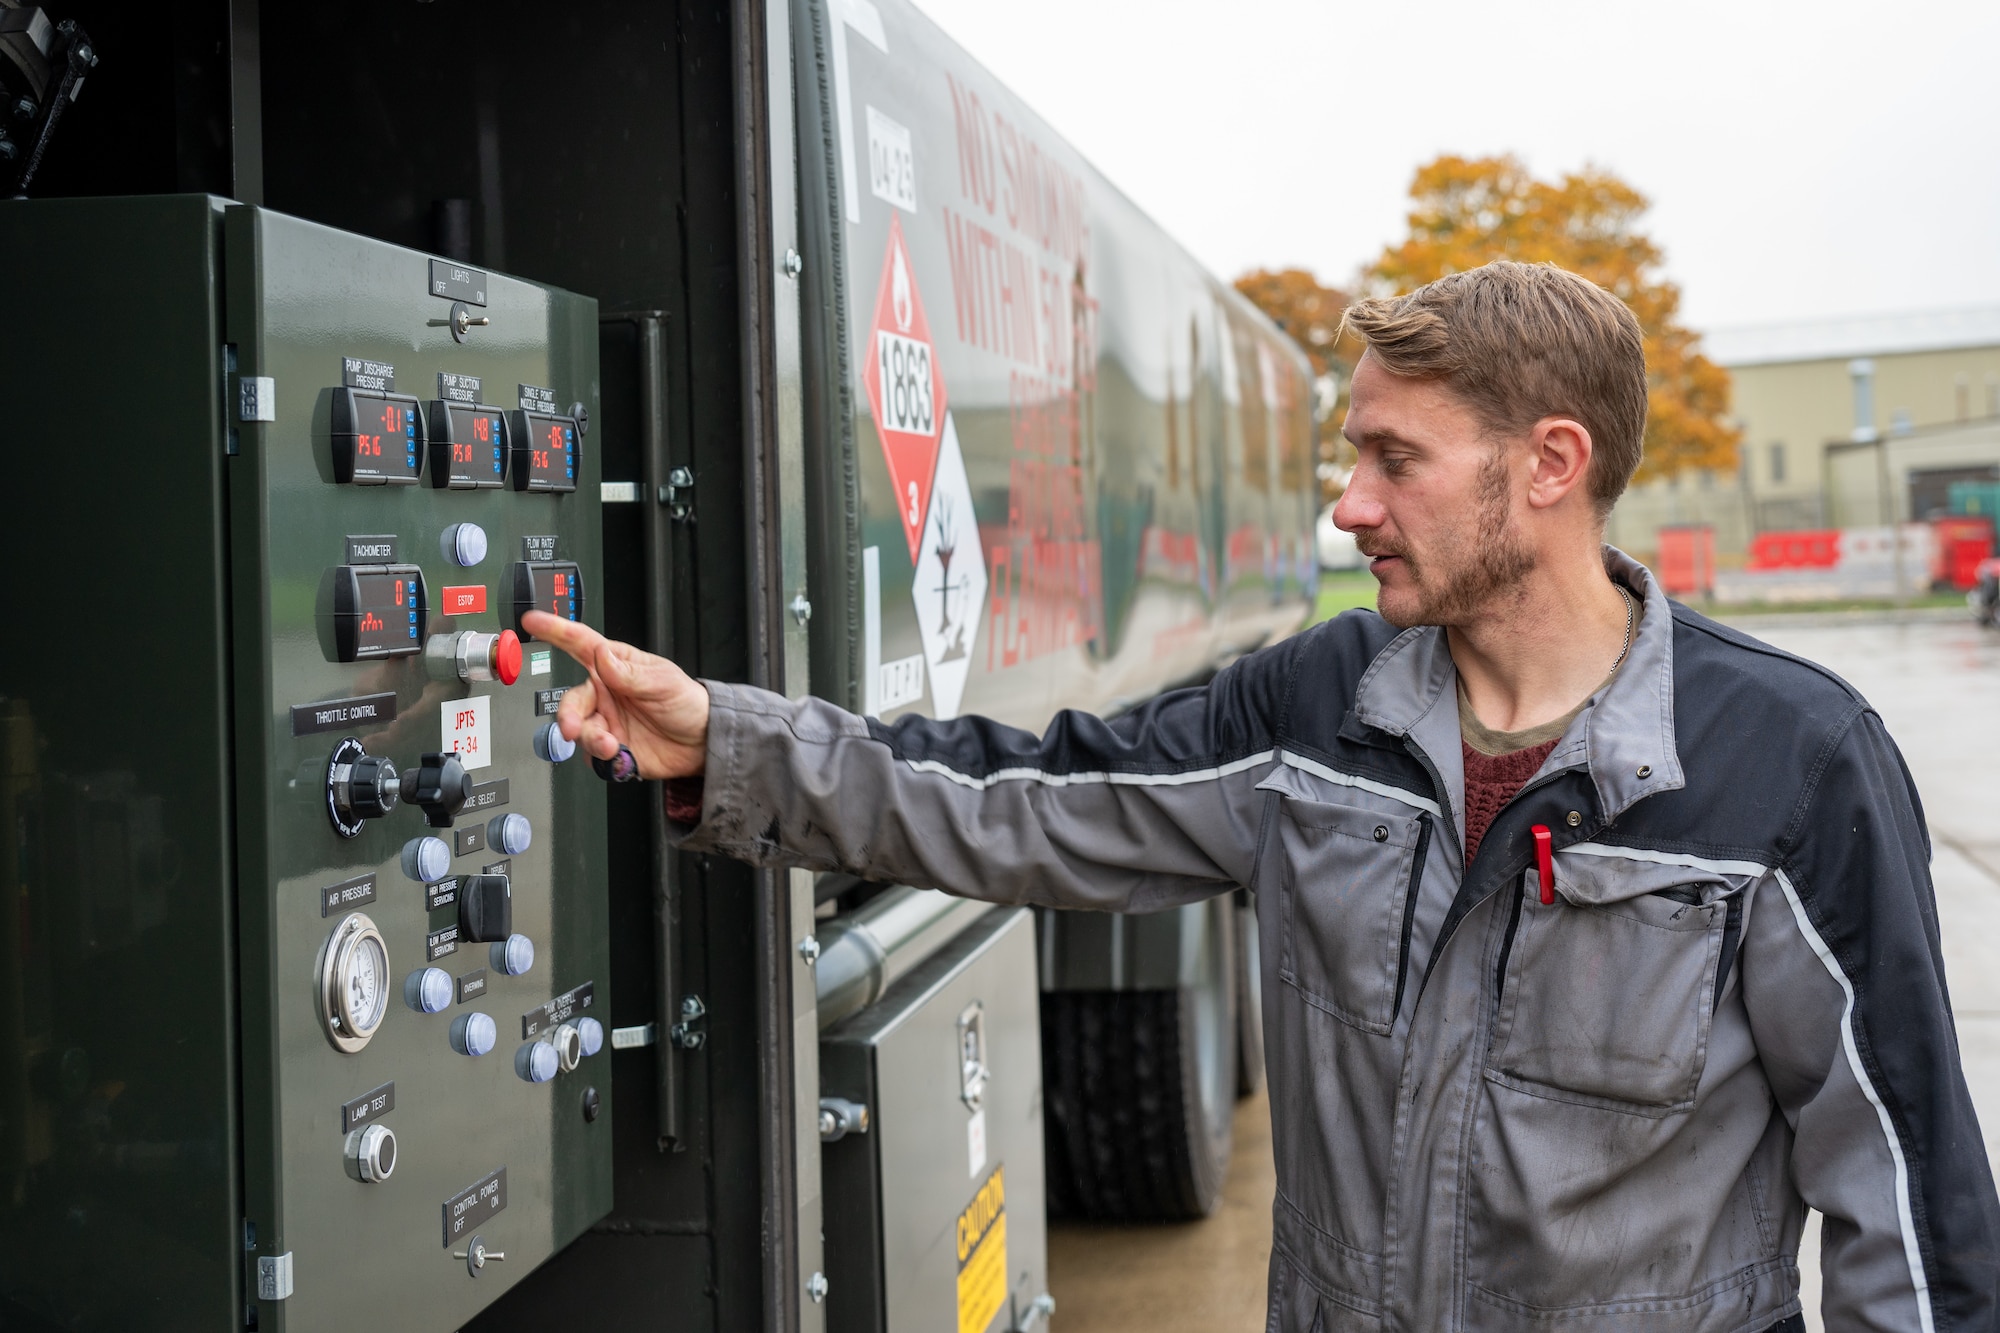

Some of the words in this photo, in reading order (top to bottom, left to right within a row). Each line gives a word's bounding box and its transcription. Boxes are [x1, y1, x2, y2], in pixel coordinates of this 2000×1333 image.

[450, 268, 470, 284] LIGHTS
[435, 280, 447, 294] OFF
[476, 290, 485, 303] ON
[345, 359, 362, 373] PUMP
[364, 361, 394, 379] DISCHARGE
[356, 374, 386, 391] PRESSURE
[443, 374, 457, 387] PUMP
[459, 377, 480, 391] SUCTION
[882, 336, 932, 433] 1863
[449, 387, 474, 402] PRESSURE
[524, 386, 539, 400] SINGLE
[540, 390, 553, 401] POINT
[520, 398, 536, 411] NOZZLE
[537, 400, 556, 414] PRESSURE
[908, 480, 920, 527] 3
[352, 544, 392, 557] TACHOMETER
[527, 538, 540, 549] FLOW
[541, 538, 556, 549] RATE/
[530, 549, 554, 561] TOTALIZER
[395, 579, 403, 606] 0
[457, 594, 475, 606] ESTOP
[541, 691, 551, 702] HIGH
[315, 708, 347, 725] THROTTLE
[350, 704, 377, 719] CONTROL
[544, 702, 560, 713] PRESS
[455, 709, 475, 730] JPTS
[351, 739, 363, 754] RPM
[329, 762, 337, 785] RPM
[478, 791, 496, 805] SELECT
[340, 822, 350, 836] RPM
[467, 835, 476, 846] OFF
[329, 891, 340, 907] AIR
[341, 882, 372, 902] PRESSURE
[429, 884, 438, 896] HIGH
[438, 879, 458, 893] PRESSURE
[433, 892, 455, 907] SERVICING
[429, 934, 439, 947] LOW
[439, 928, 458, 942] PRESSURE
[434, 942, 455, 957] SERVICING
[464, 978, 484, 994] OVERWING
[583, 995, 592, 1008] DRY
[544, 1005, 556, 1017] TANK
[527, 1022, 538, 1036] WET
[351, 1103, 369, 1122] LAMP
[371, 1094, 387, 1111] TEST
[453, 1193, 478, 1217] CONTROL
[480, 1179, 499, 1200] POWER
[490, 1194, 499, 1208] ON
[957, 1164, 1005, 1262] CAUTION
[454, 1216, 465, 1233] OFF
